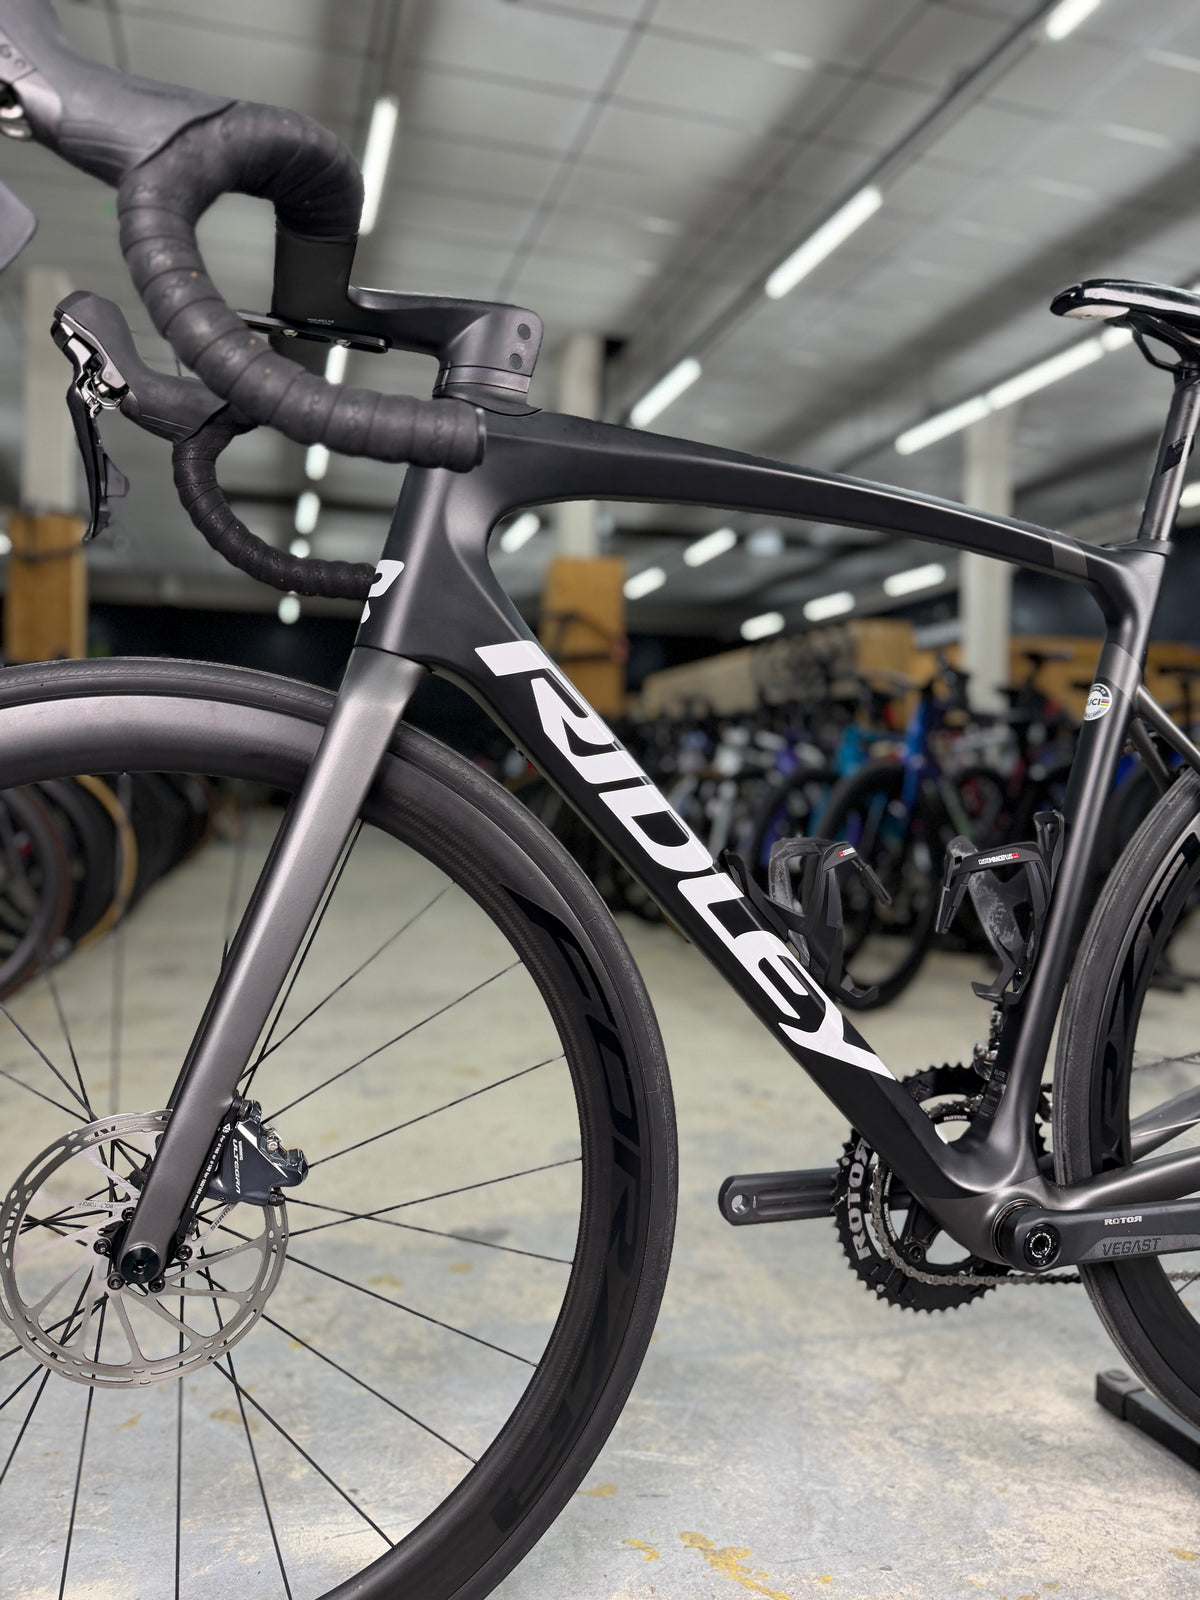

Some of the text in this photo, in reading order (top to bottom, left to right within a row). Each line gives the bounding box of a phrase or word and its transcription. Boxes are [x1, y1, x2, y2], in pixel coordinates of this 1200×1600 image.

[475, 640, 897, 1081] RIDLEY
[232, 1139, 241, 1195] ULTEGRA
[847, 1137, 872, 1261] ROTOR
[1104, 1215, 1143, 1226] ROTOR
[1102, 1237, 1162, 1257] VEGAST
